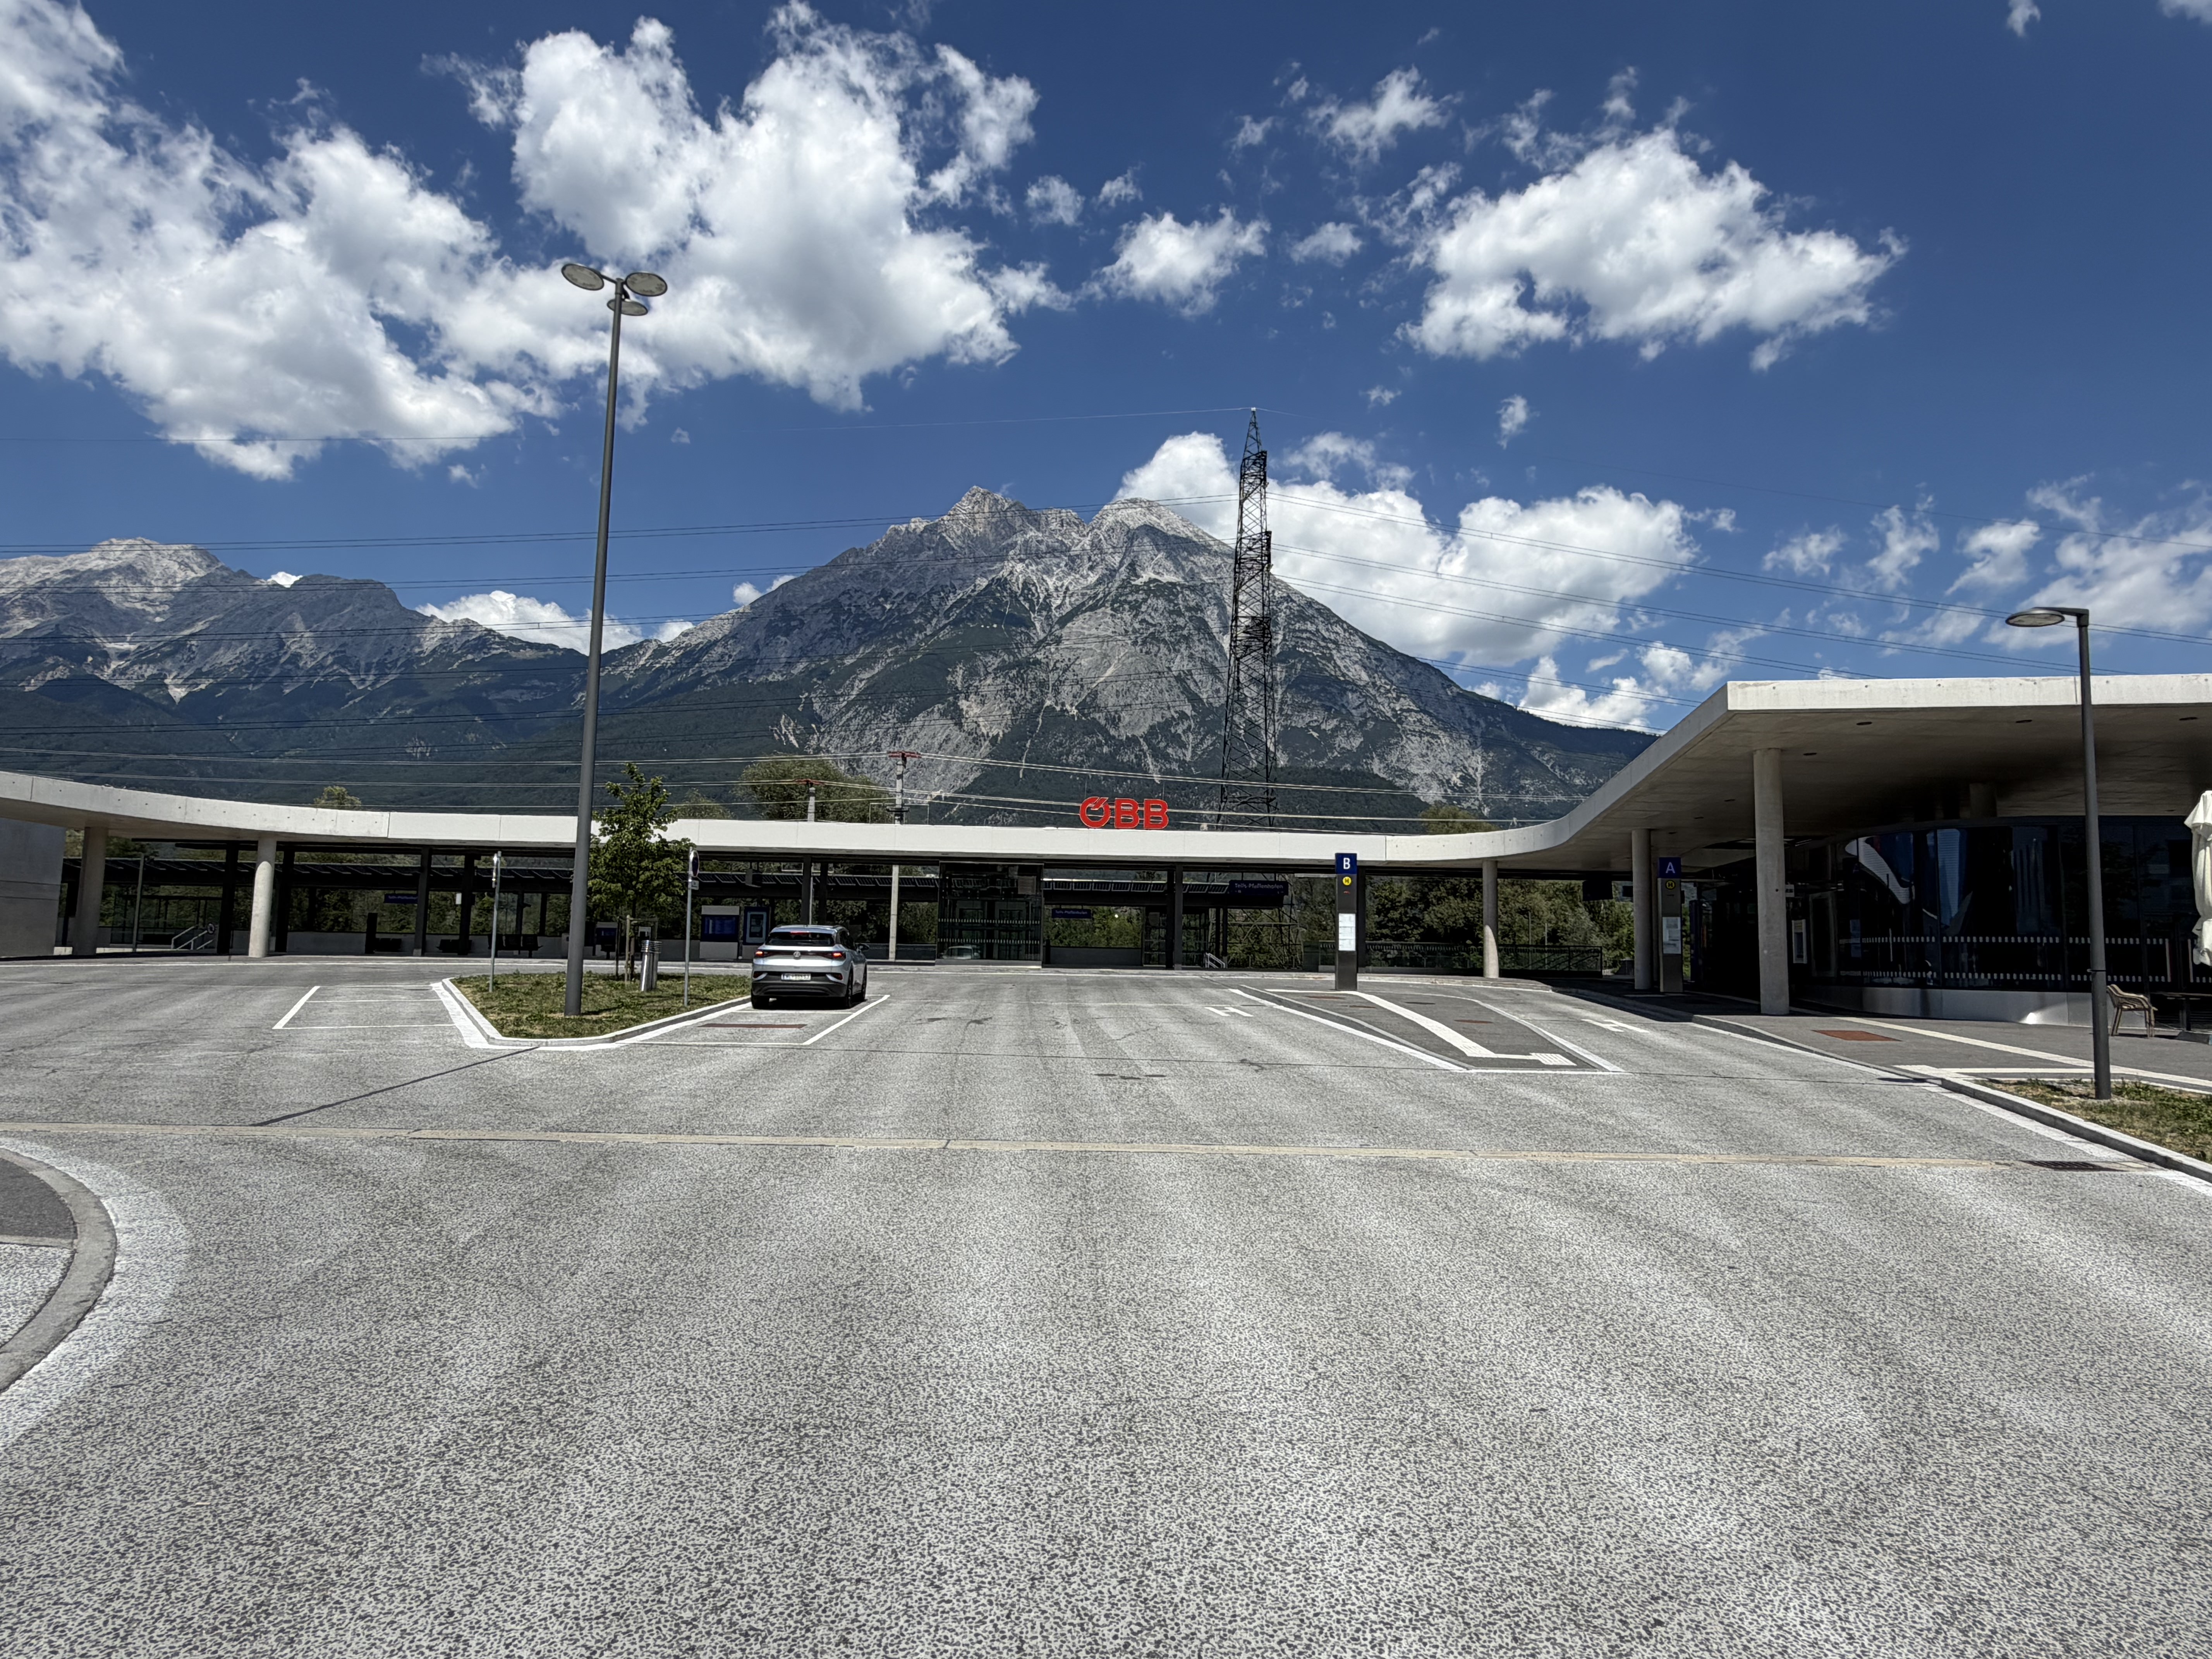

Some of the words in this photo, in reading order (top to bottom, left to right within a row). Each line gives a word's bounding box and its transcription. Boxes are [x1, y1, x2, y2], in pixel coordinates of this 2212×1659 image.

[1079, 796, 1169, 830] ÖBB
[1343, 857, 1351, 870] B
[1665, 862, 1676, 874] A
[1204, 1006, 1254, 1017] H
[1581, 1018, 1650, 1033] H
